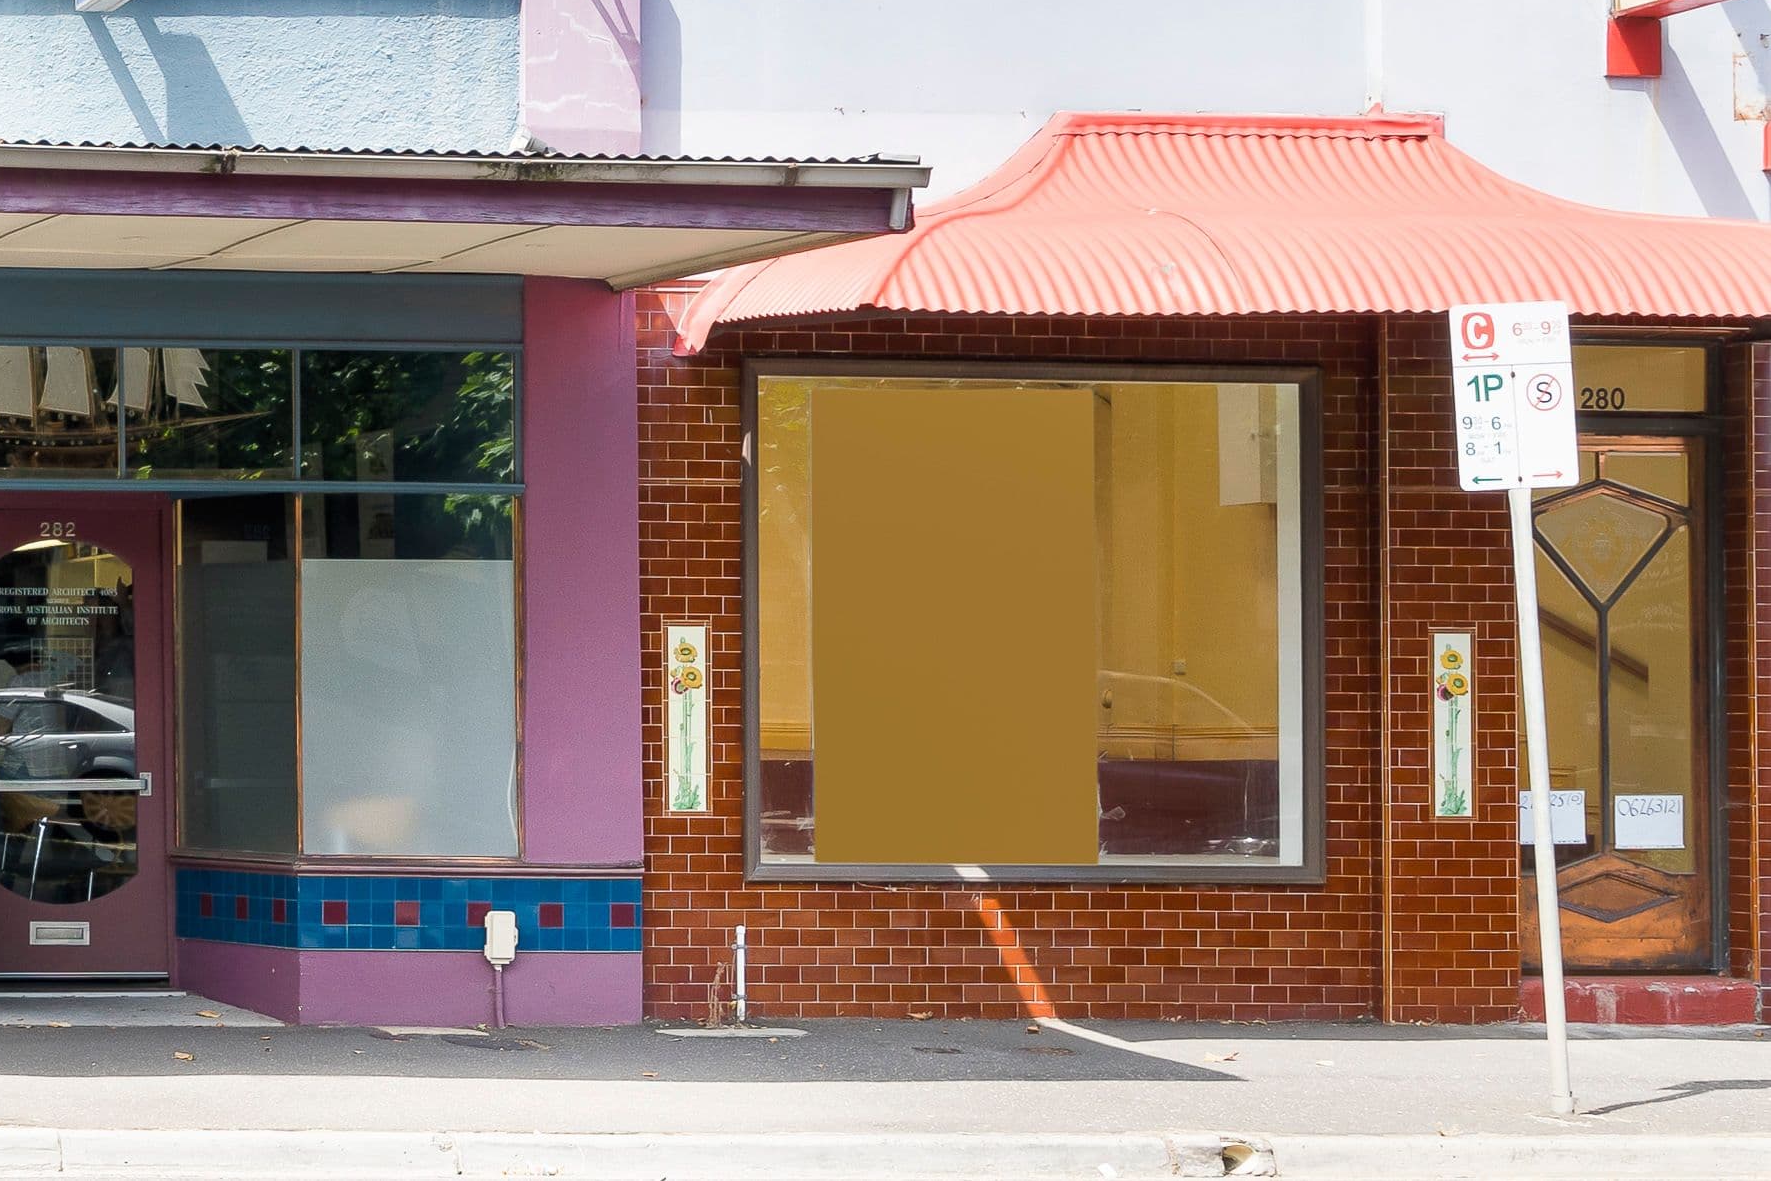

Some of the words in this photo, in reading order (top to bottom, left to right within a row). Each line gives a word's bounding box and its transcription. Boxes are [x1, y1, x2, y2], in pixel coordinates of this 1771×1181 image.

[1466, 373, 1503, 403] 1P
[1580, 386, 1626, 410] 280
[39, 522, 76, 537] 282
[51, 587, 96, 596] ARCHITECT
[25, 605, 73, 615] AUSTRALIAN
[76, 605, 119, 615] INSTITUTE
[26, 616, 37, 626] OF
[40, 616, 90, 626] ARCHITECTS
